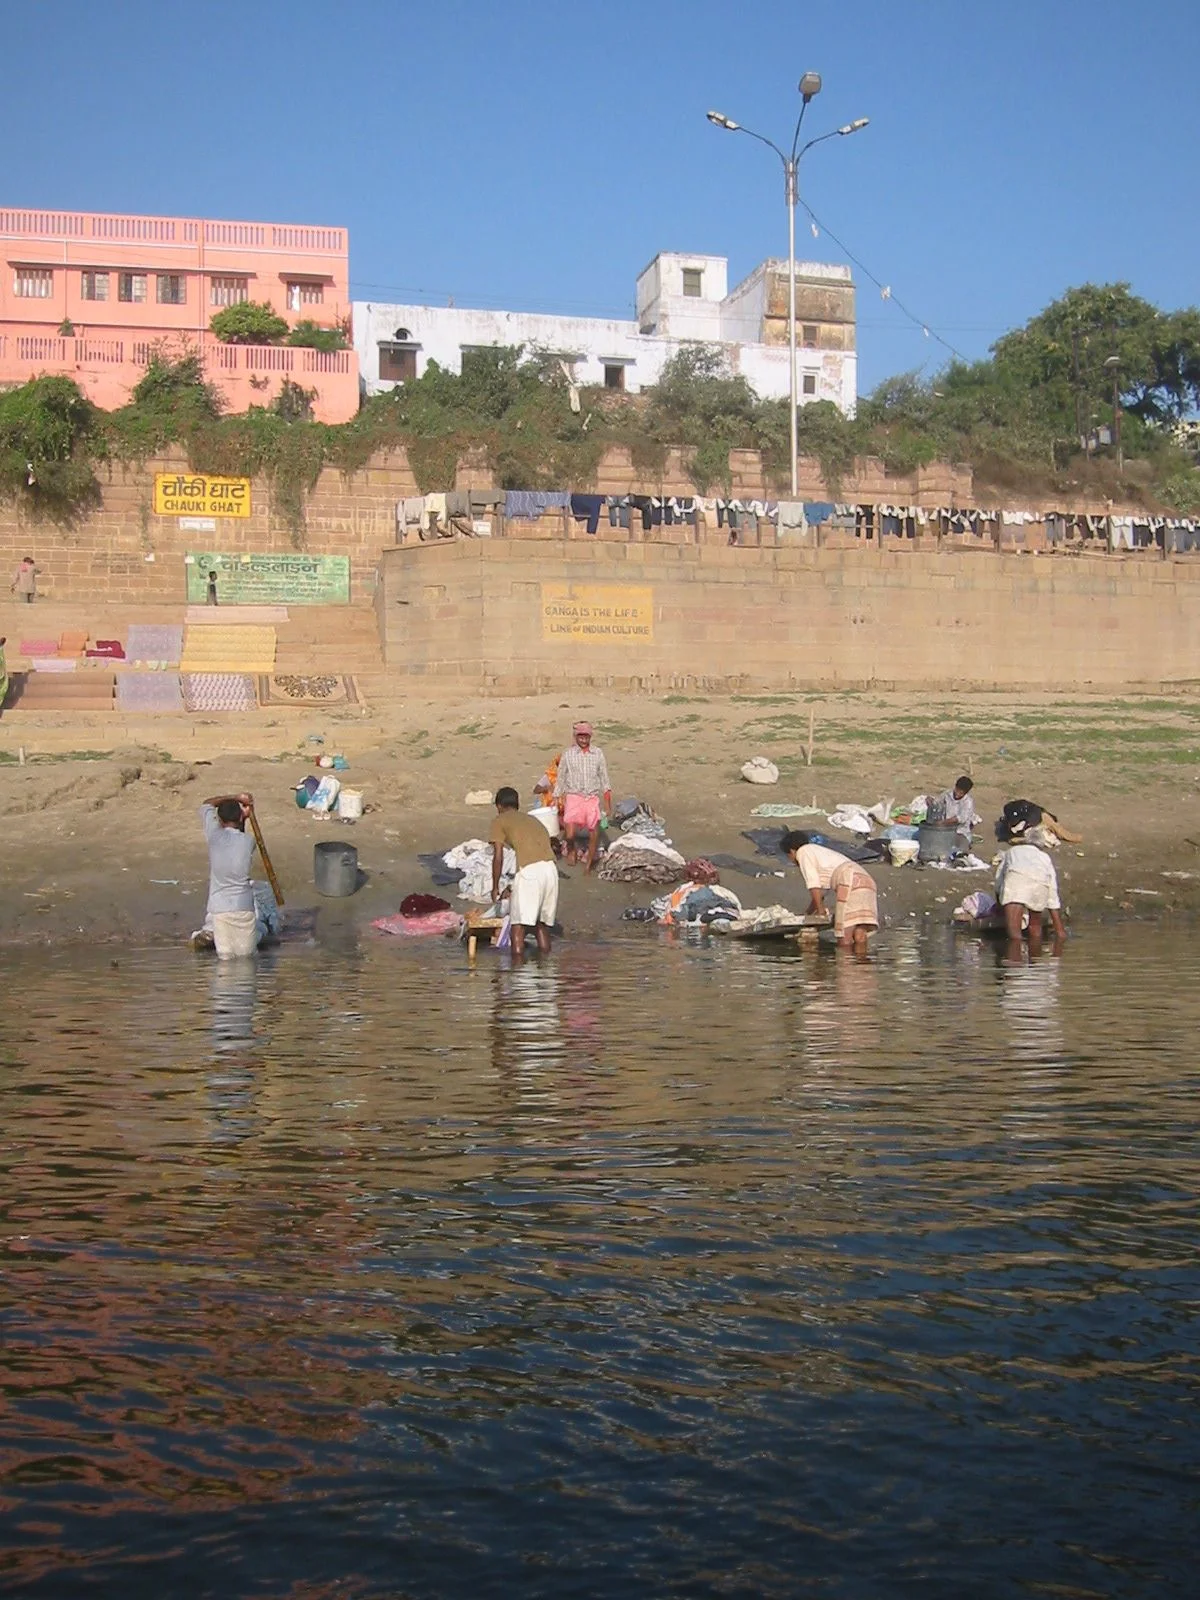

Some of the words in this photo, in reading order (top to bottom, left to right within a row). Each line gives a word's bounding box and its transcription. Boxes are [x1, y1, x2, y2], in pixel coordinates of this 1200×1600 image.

[162, 476, 206, 497] चौकी
[209, 483, 246, 498] घाट
[164, 500, 206, 512] CHAUKI
[210, 501, 242, 513] GHAT
[544, 606, 578, 617] GANGA
[580, 607, 590, 617] IS
[592, 607, 612, 617] THE
[550, 624, 572, 633] LINE
[582, 624, 611, 634] INDIAN
[612, 625, 649, 635] CULTURE
